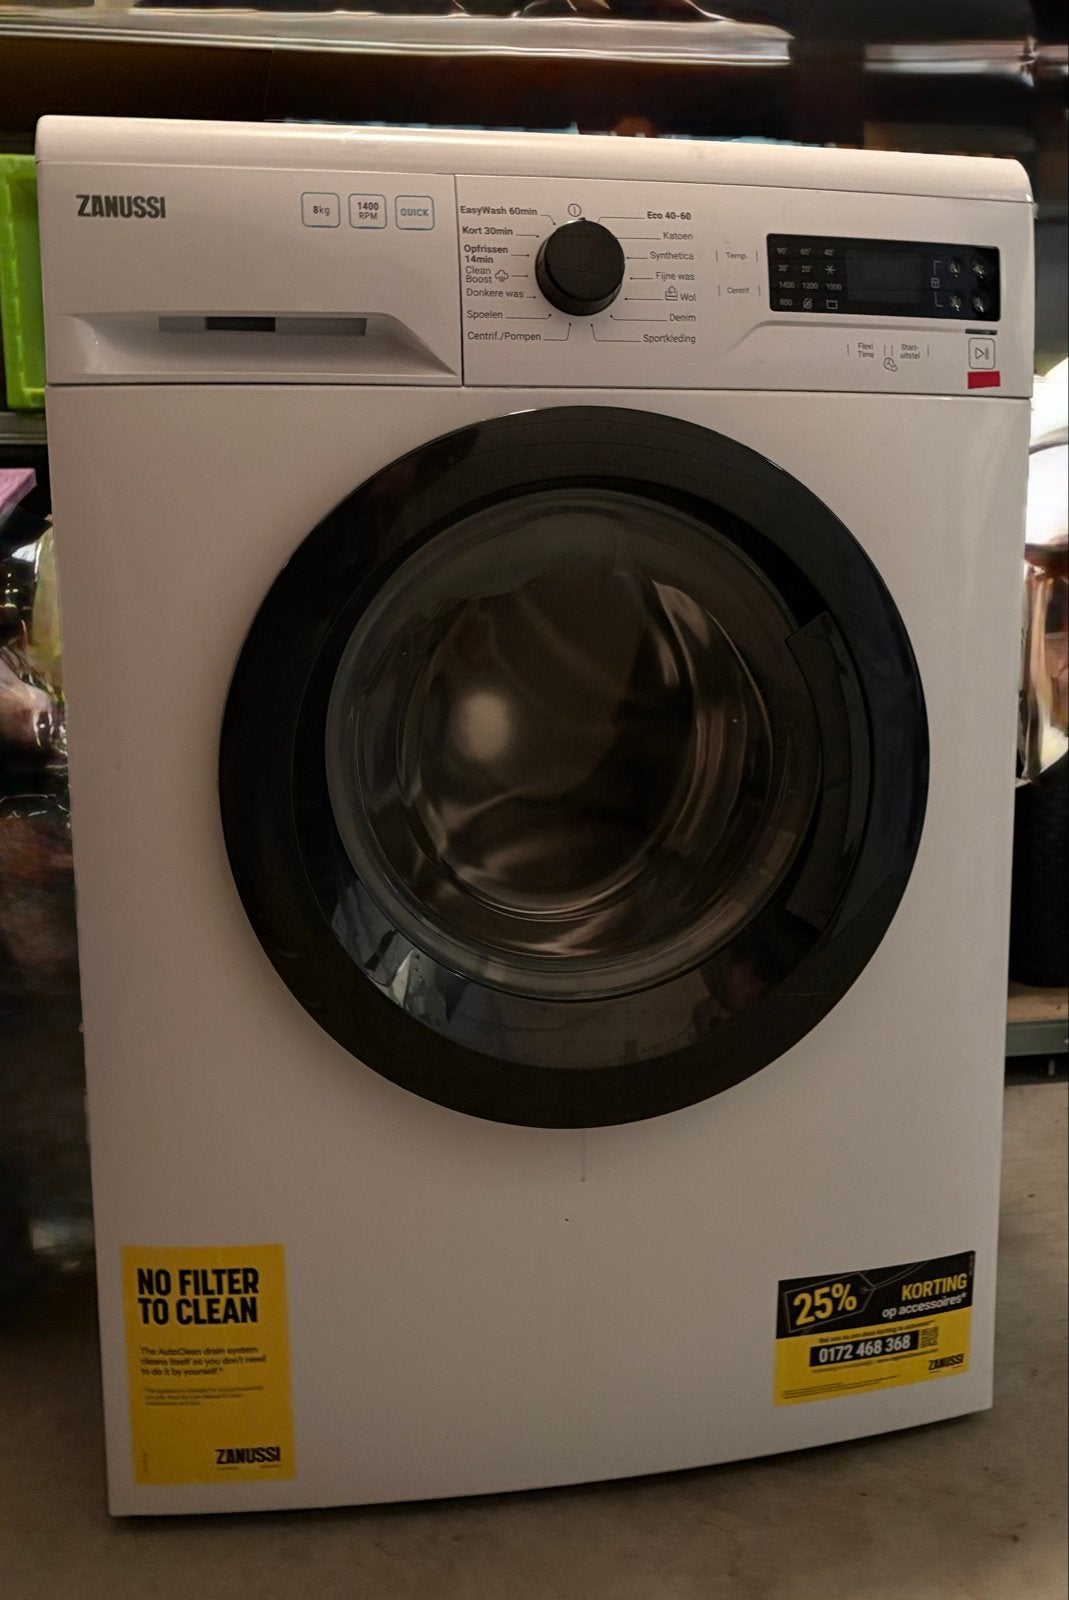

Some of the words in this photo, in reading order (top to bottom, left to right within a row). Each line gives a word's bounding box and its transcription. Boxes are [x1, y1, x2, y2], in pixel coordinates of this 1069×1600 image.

[76, 194, 166, 219] ZANUSSI
[312, 204, 331, 217] 8kg
[356, 201, 380, 212] 1400
[460, 206, 507, 217] EasyWash
[509, 207, 538, 216] 60min
[358, 211, 378, 221] RPM
[400, 207, 429, 218] QUICK
[647, 211, 663, 220] Eco
[664, 211, 692, 220] 40-60
[462, 226, 482, 235] Kort
[484, 226, 514, 236] 30min
[663, 231, 694, 240] Katoen
[464, 244, 509, 255] Opfrissen
[465, 256, 494, 264] 14min
[650, 251, 695, 262] Synthetica
[465, 266, 491, 275] Clean
[465, 275, 492, 284] Boost
[655, 272, 678, 282] Fijne
[679, 273, 695, 281] was
[466, 288, 504, 298] Donkere
[505, 290, 524, 298] was
[680, 293, 697, 302] Wol
[467, 310, 503, 320] Spoelen
[669, 313, 697, 322] Denim
[467, 331, 541, 342] Centrif./Pompen
[643, 334, 696, 344] Sportkleding
[857, 350, 875, 359] Time
[137, 1268, 171, 1296] NO
[179, 1267, 259, 1296] FILTER
[901, 1272, 968, 1302] KORTING
[793, 1282, 857, 1327] 25%
[138, 1298, 169, 1325] TO
[176, 1296, 258, 1325] CLEAN
[881, 1307, 898, 1320] op
[818, 1345, 853, 1364] 0172
[857, 1339, 883, 1357] 468
[884, 1334, 911, 1352] 368
[928, 1353, 964, 1371] ZANUSSI
[215, 1446, 281, 1465] ZANUSSI
